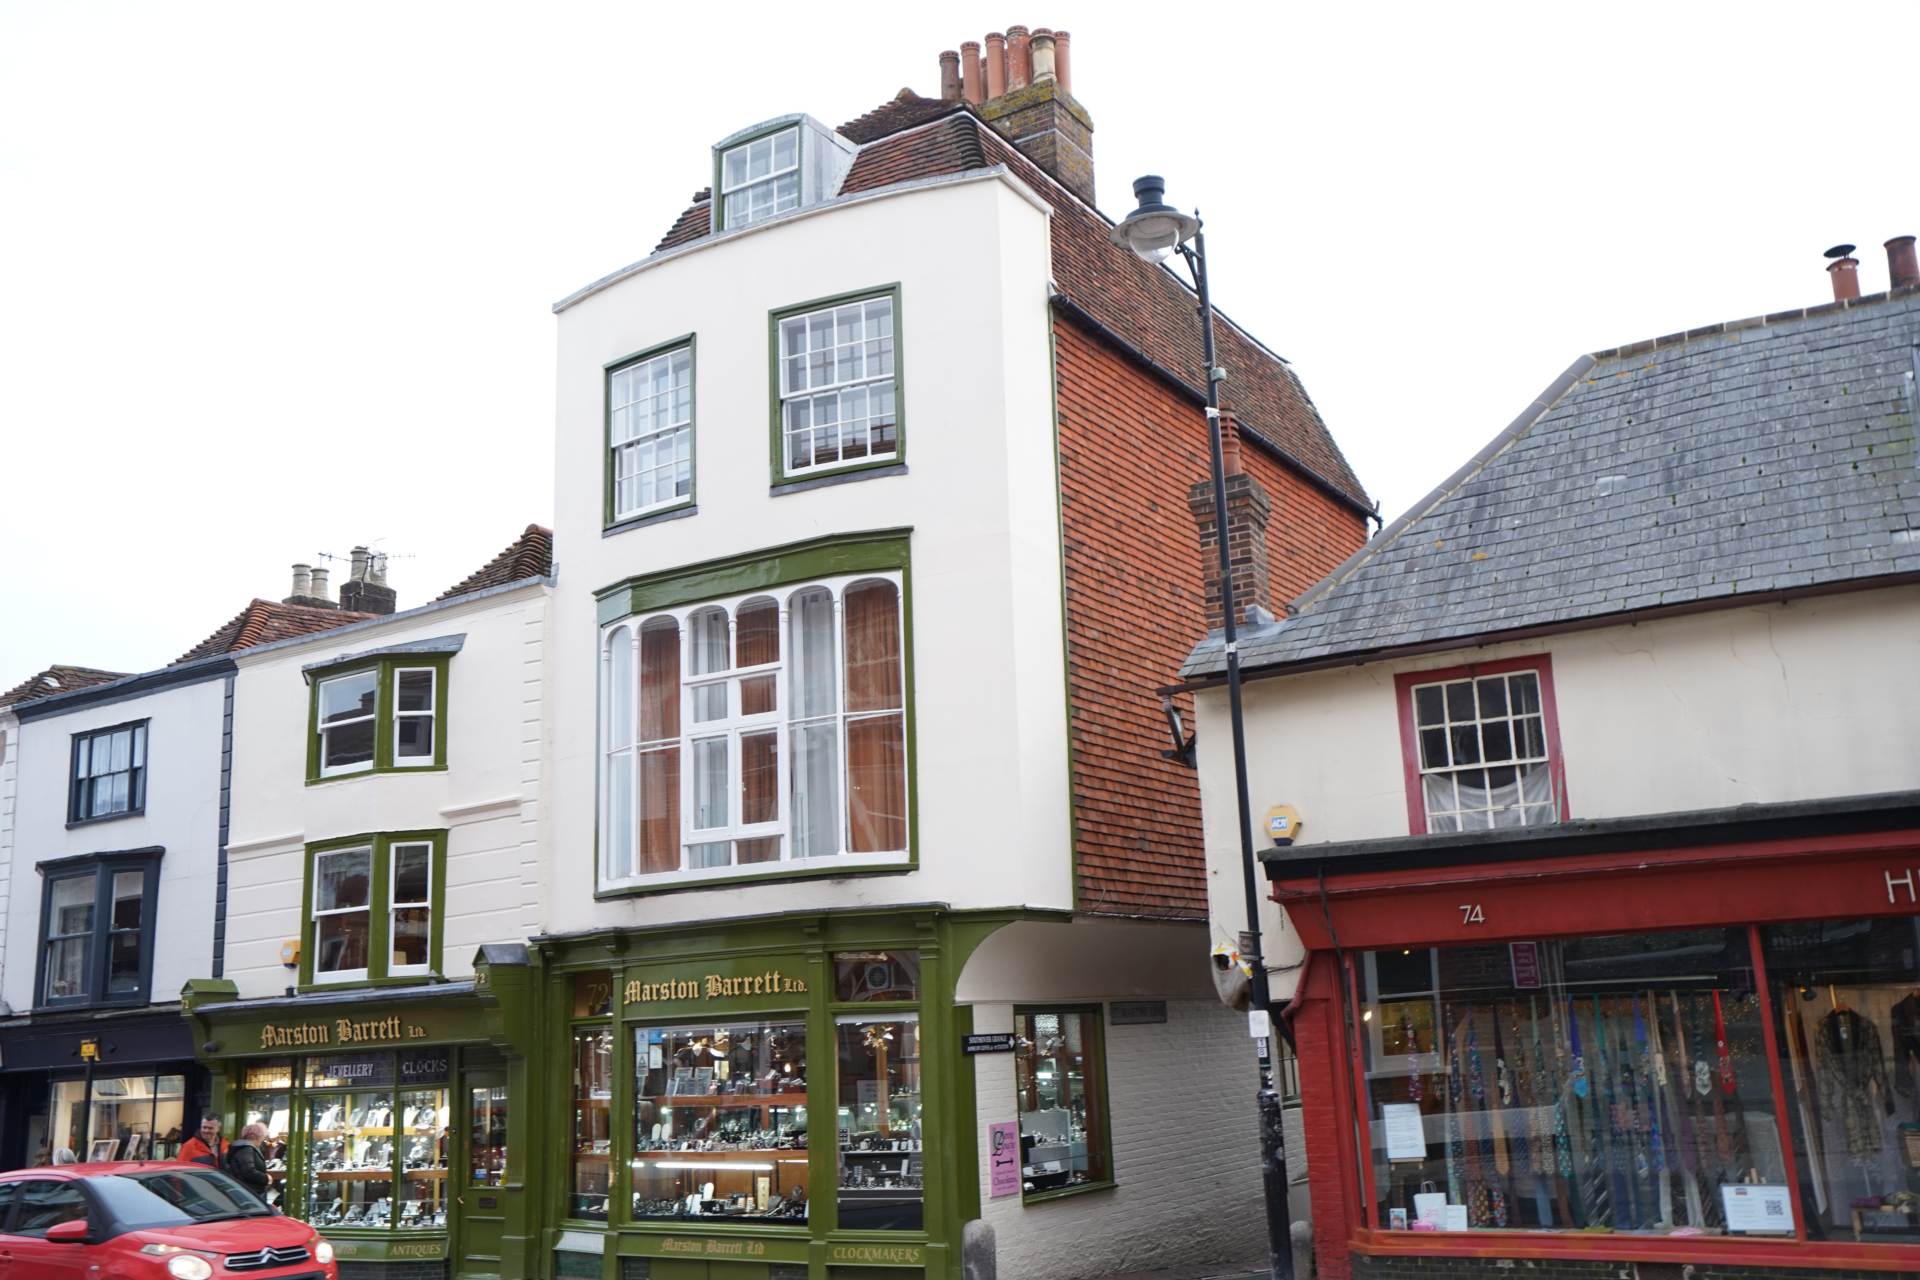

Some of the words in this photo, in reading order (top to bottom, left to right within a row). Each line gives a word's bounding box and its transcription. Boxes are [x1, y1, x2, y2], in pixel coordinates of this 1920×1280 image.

[1884, 868, 1920, 904] H
[1458, 904, 1486, 925] 74
[587, 983, 608, 1006] 72
[623, 978, 700, 1005] Marston
[704, 970, 781, 1000] Barrett
[260, 1023, 329, 1049] Marston
[336, 1016, 401, 1046] Barrett
[327, 1063, 374, 1078] JEWELLERY
[402, 1059, 448, 1074] CLOCKS
[391, 1244, 441, 1257] ANTIQUES
[833, 1247, 920, 1263] CLOCKMAKERS
